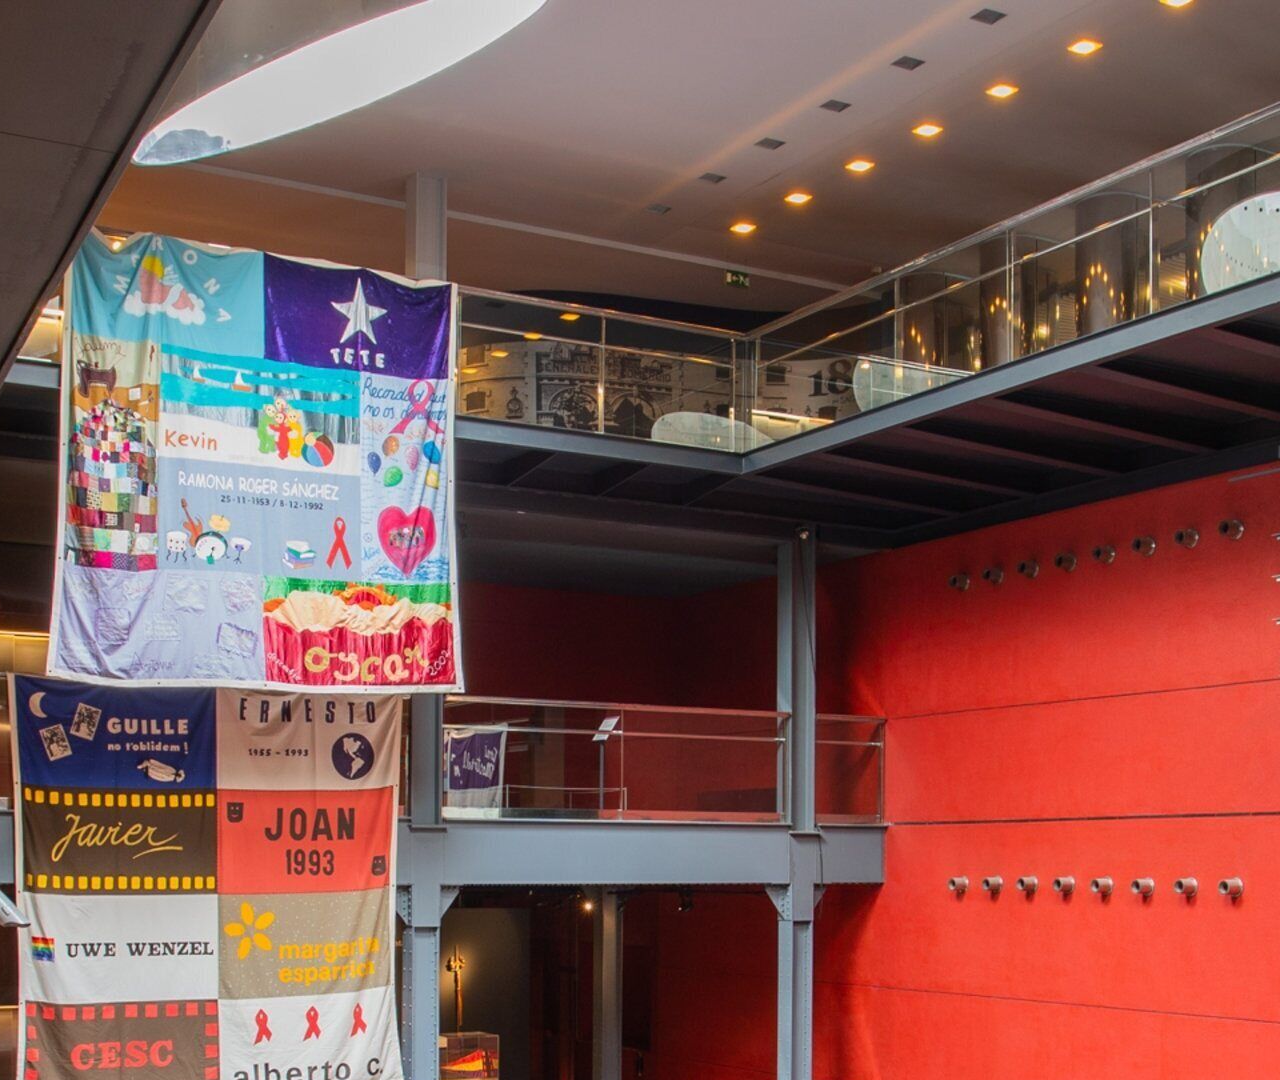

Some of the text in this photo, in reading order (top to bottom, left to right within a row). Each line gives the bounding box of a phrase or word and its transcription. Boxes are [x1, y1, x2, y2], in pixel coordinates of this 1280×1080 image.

[330, 347, 386, 369] TETE
[808, 360, 854, 397] 18
[165, 429, 218, 451] Kevin
[177, 470, 340, 501] RAMONA ROGER SÁNCHEZ
[239, 697, 376, 725] ERNESTO
[107, 716, 189, 736] GUILLE
[107, 742, 122, 752] no
[284, 749, 310, 758] 1993
[264, 807, 357, 842] JOAN
[51, 812, 181, 863] Javier
[284, 849, 335, 877] 1993
[65, 940, 215, 959] UWE WENZEL
[70, 1039, 174, 1071] CESC
[367, 1056, 384, 1076] c.
